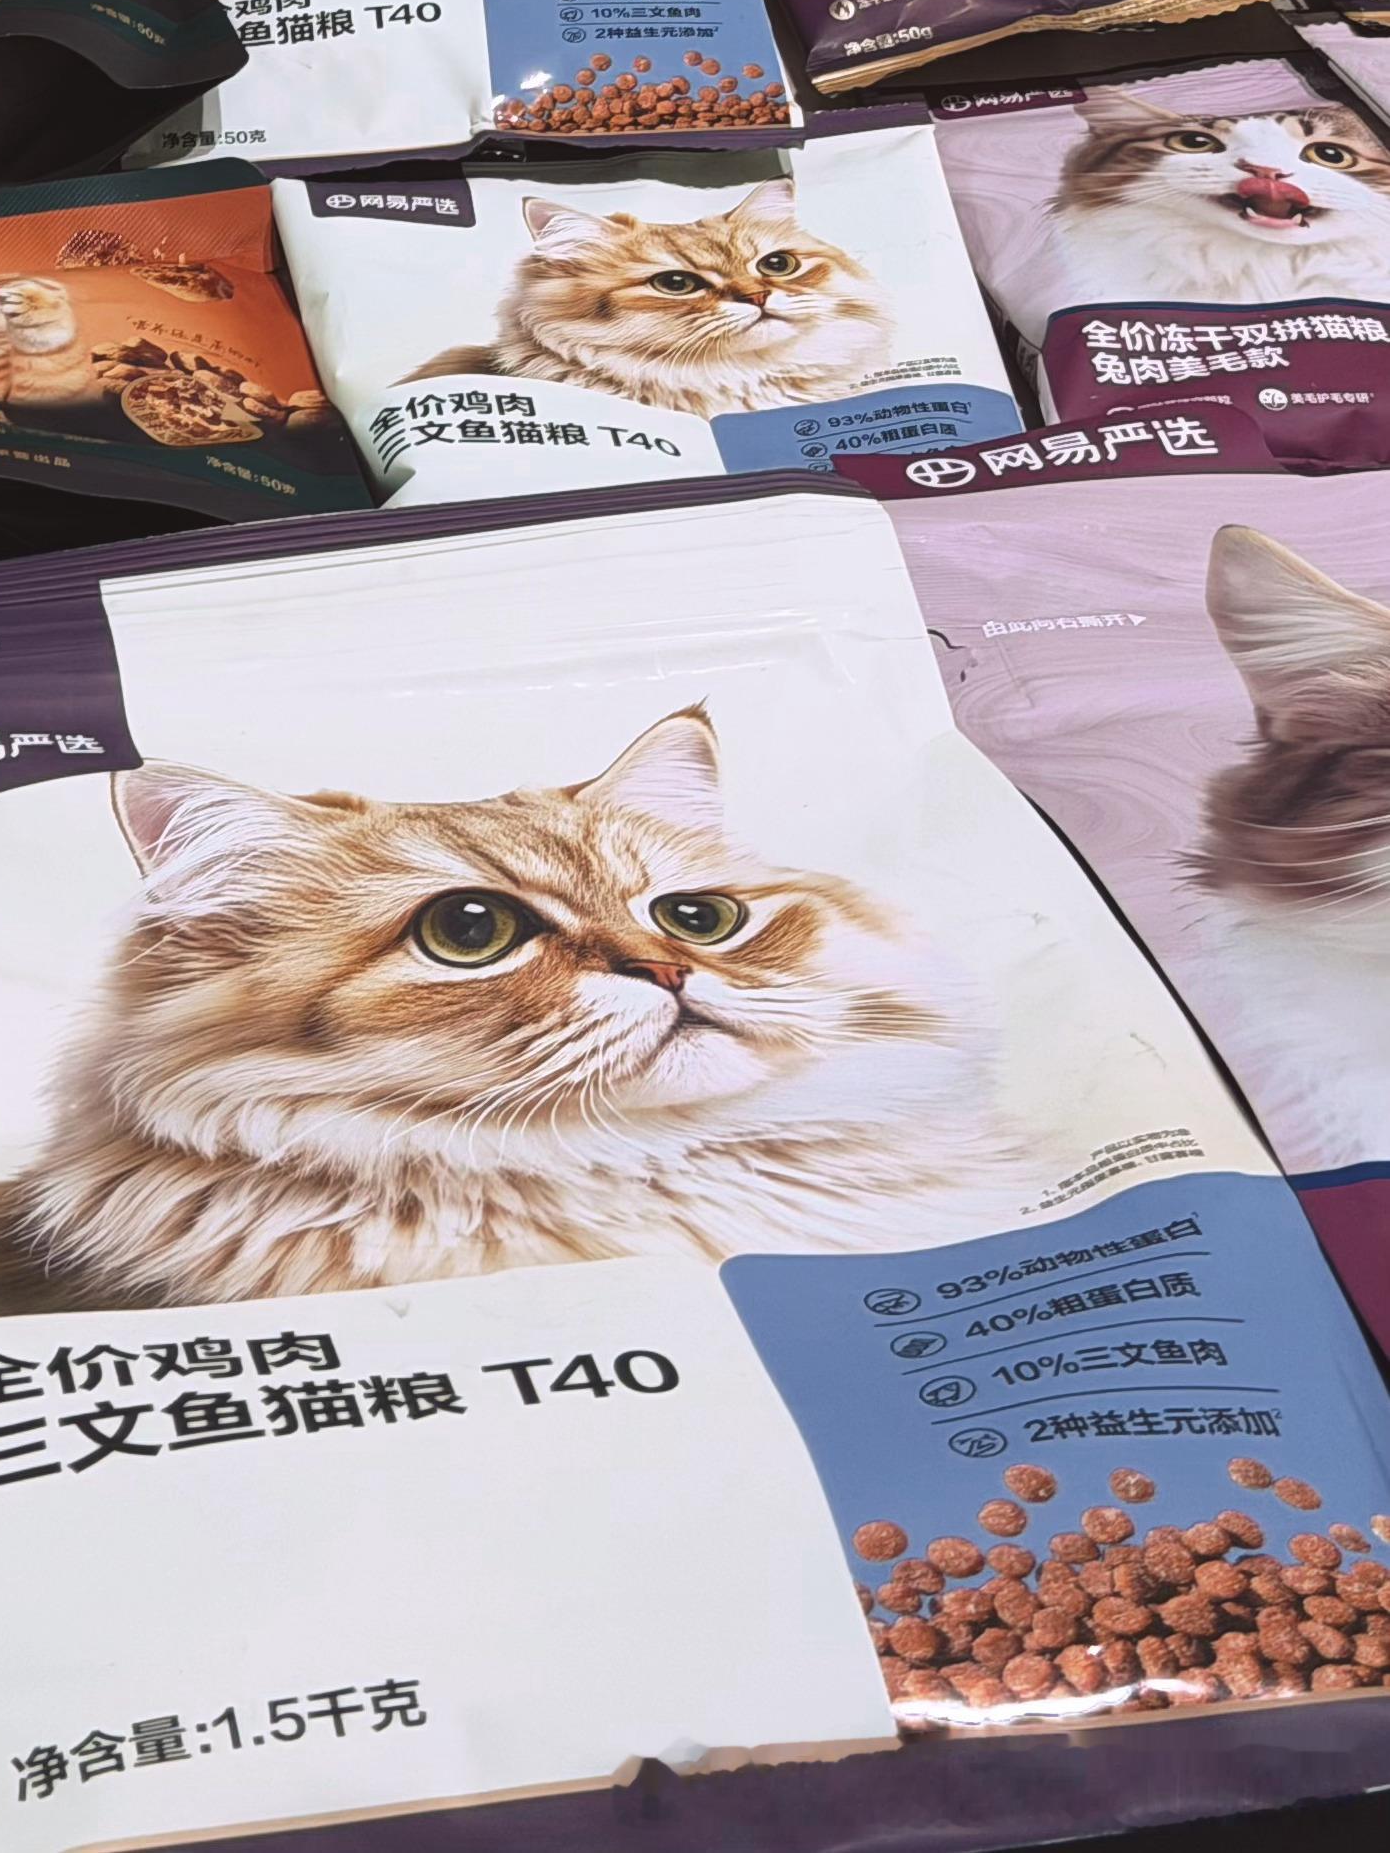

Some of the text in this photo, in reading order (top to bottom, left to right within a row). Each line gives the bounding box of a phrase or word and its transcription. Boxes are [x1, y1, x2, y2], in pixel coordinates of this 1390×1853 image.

[364, 1, 442, 29] T40
[359, 194, 460, 217] 网易严选
[1082, 314, 1390, 354] 全价冻干双拼猫粮
[1091, 346, 1291, 386] 兔肉美毛款
[368, 389, 537, 436] 全价鸡肉
[597, 426, 681, 459] T40
[835, 423, 958, 451] 40%粗蛋白质
[981, 416, 1220, 477] 网易严选
[965, 1271, 1201, 1341] 40%粗蛋白质
[481, 1348, 681, 1408] T40
[991, 1338, 1228, 1386] 10%三文鱼肉
[10, 1678, 429, 1804] 净含量:1.5千克
